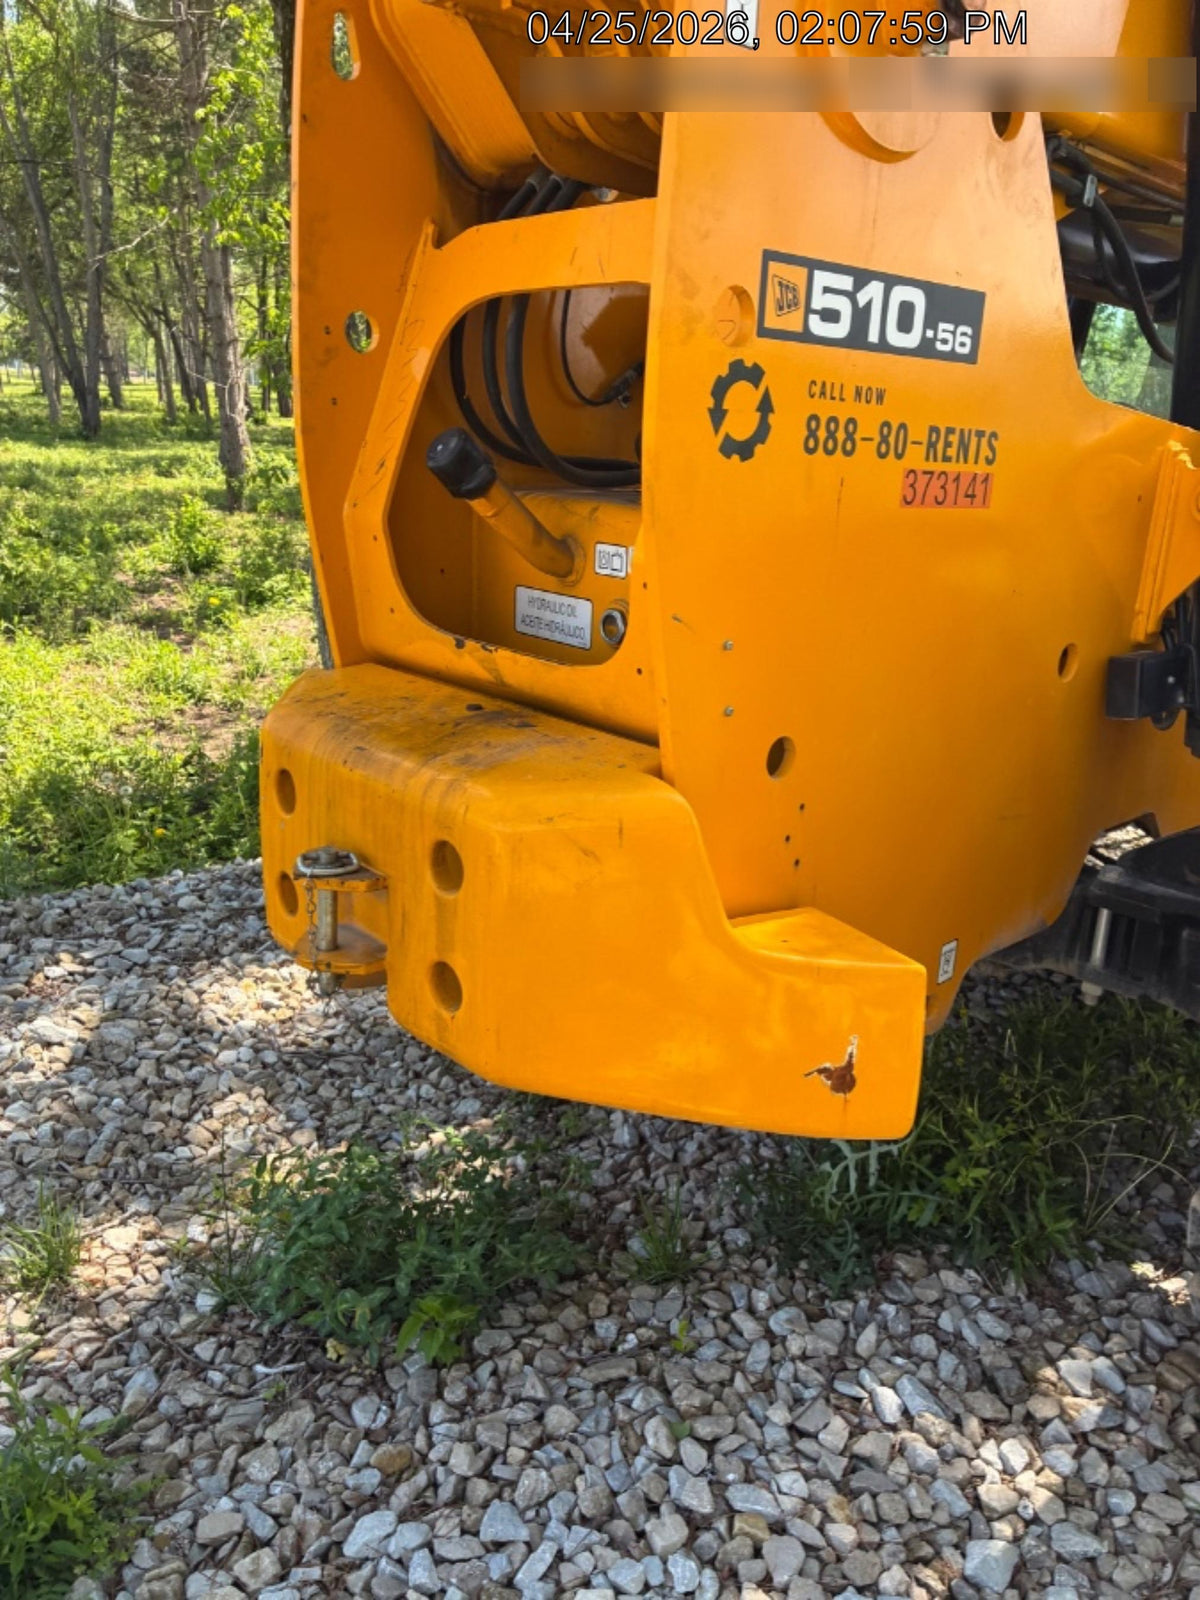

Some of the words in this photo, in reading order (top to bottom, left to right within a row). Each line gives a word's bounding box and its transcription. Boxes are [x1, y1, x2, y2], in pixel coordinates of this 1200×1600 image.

[775, 279, 800, 312] JCB
[808, 379, 846, 402] CALL
[854, 385, 887, 405] NOW
[803, 413, 999, 467] 888-80-RENTS
[902, 468, 992, 507] 373141
[527, 595, 566, 616] HYDRAULIC
